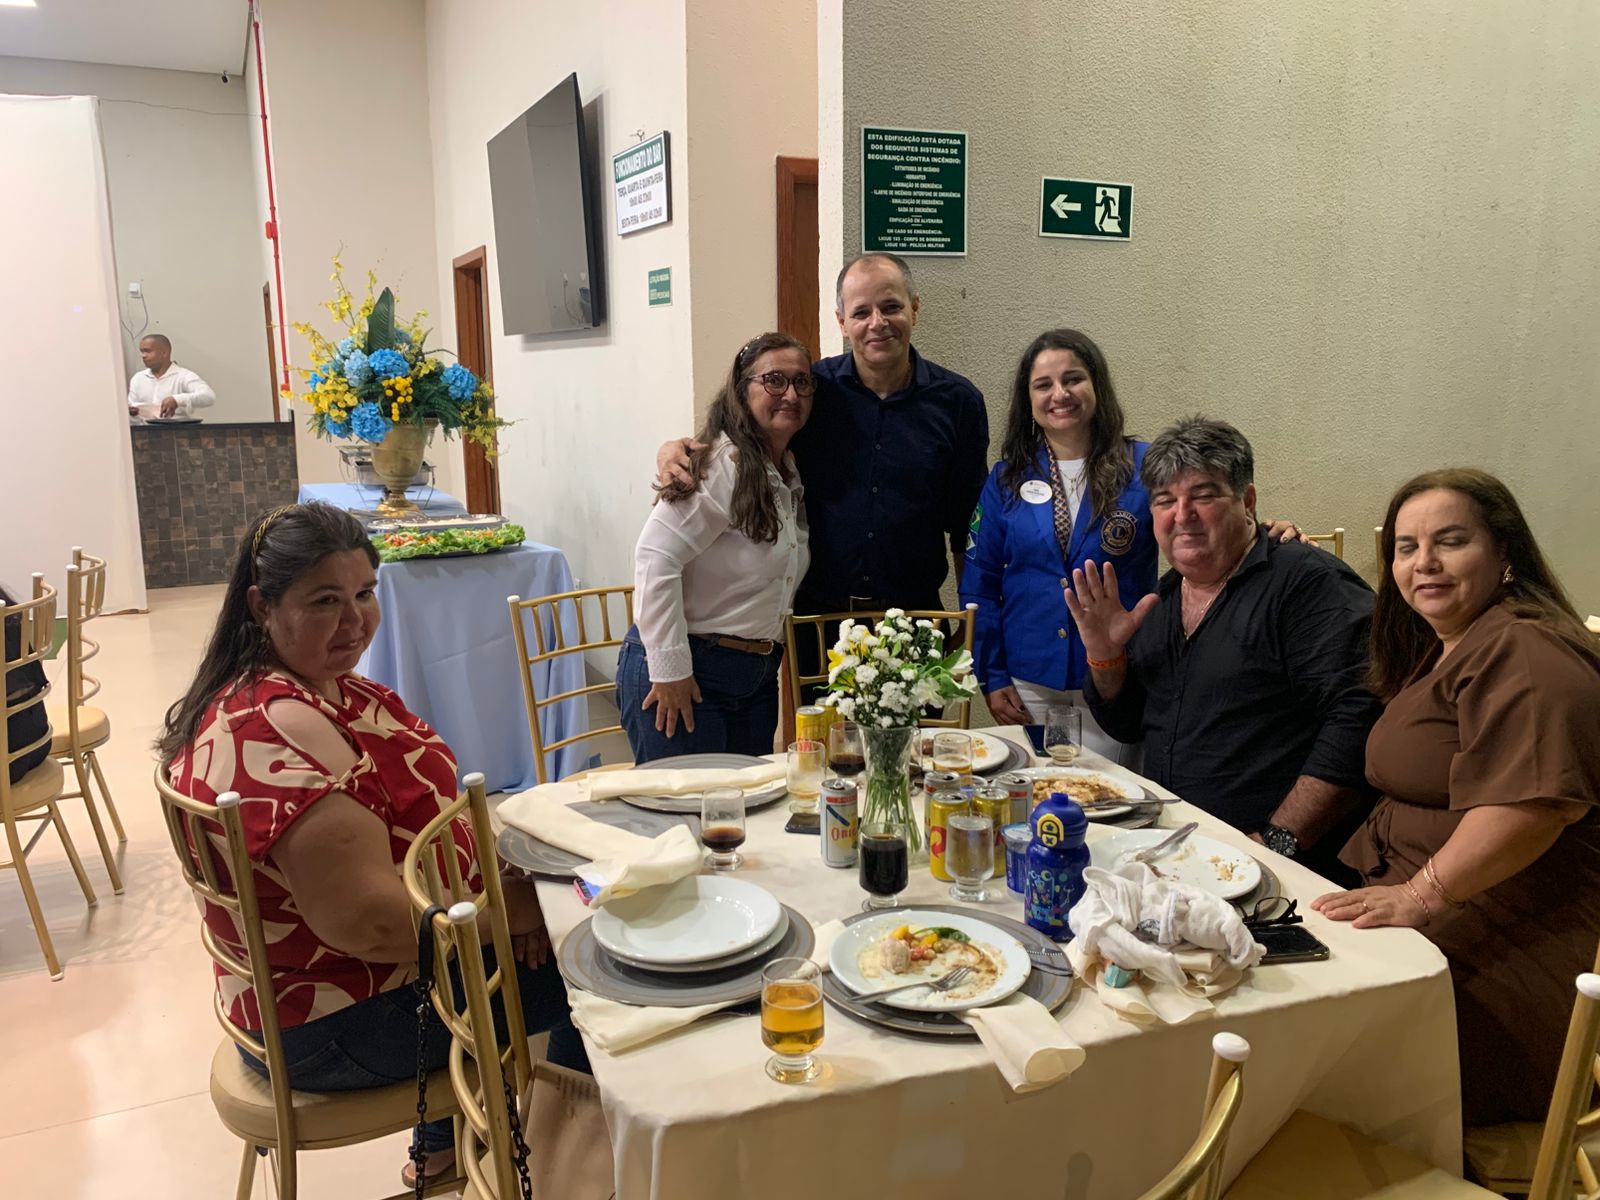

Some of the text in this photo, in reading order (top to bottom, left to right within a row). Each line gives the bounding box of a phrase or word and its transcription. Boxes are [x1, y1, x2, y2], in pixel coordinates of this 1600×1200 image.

[884, 134, 920, 143] EDIFICAÇÃO
[922, 136, 937, 144] ESTÁ
[868, 154, 904, 162] SEGURANÇA
